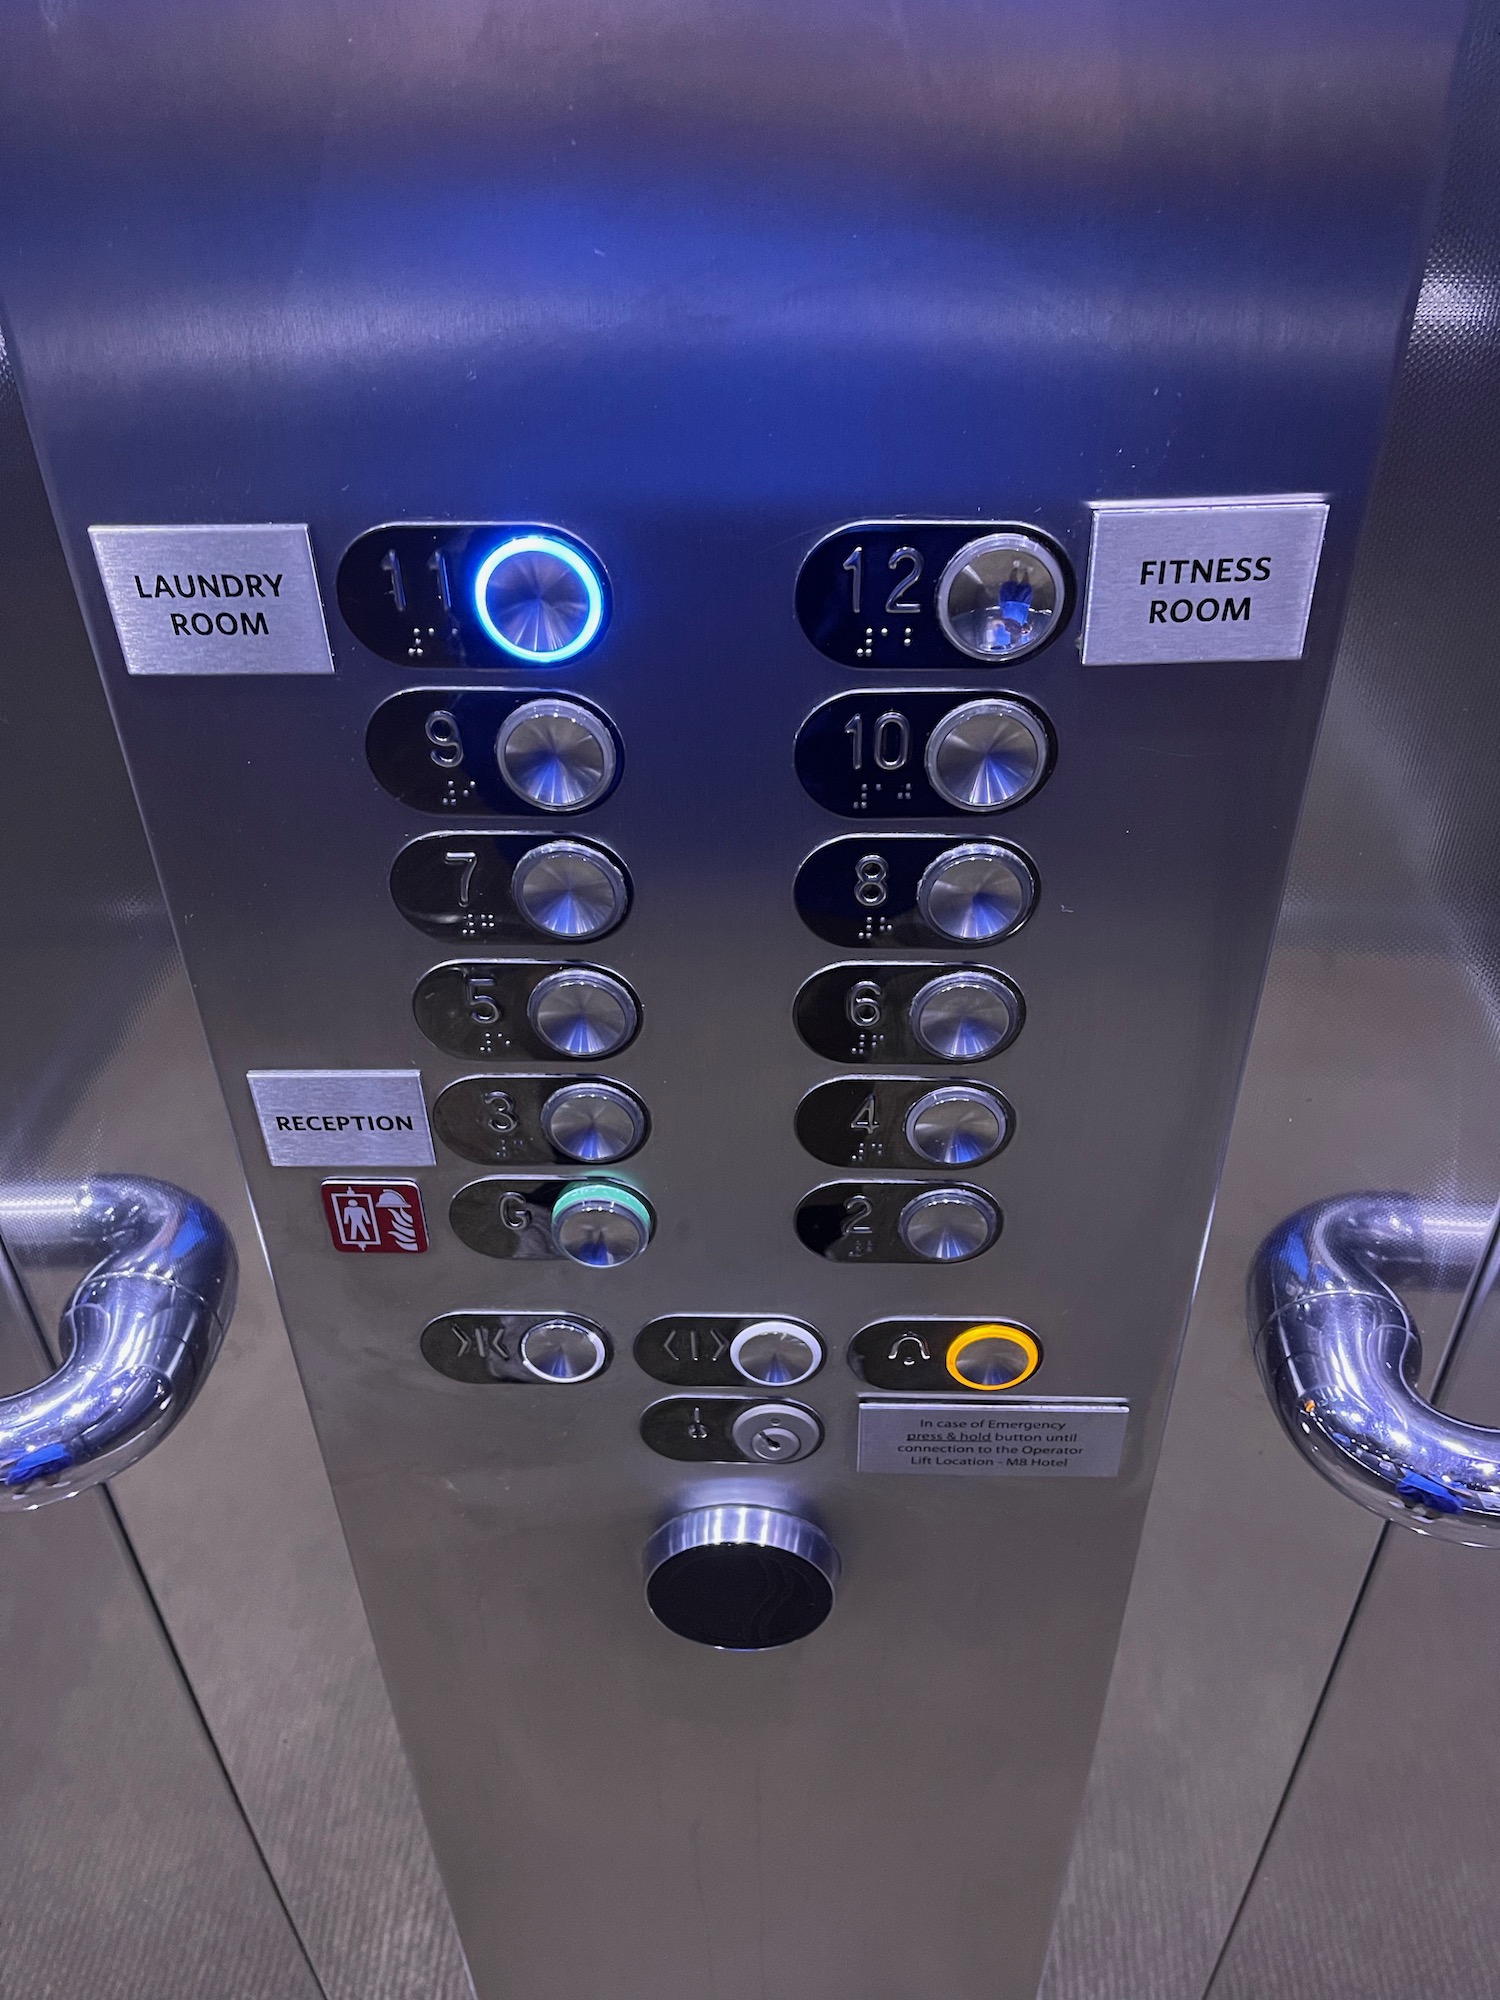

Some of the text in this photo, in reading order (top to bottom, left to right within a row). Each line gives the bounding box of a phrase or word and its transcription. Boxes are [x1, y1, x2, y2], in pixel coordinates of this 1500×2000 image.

[134, 573, 283, 598] LAUNDRY
[380, 549, 452, 611] 11
[842, 546, 922, 614] 12
[1140, 557, 1271, 585] FITNESS
[170, 612, 270, 636] ROOM
[1148, 597, 1251, 624] ROOM
[424, 709, 463, 767] 9
[844, 711, 910, 770] 10
[444, 851, 477, 907] 7
[854, 854, 888, 907] 8
[467, 977, 500, 1024] 5
[849, 980, 881, 1027] 6
[275, 1116, 414, 1132] RECEPTION
[484, 1090, 519, 1132] 3
[850, 1093, 879, 1134] 4
[499, 1191, 532, 1230] G
[843, 1195, 872, 1235] 2
[907, 1431, 1077, 1442] press & hold button until
[919, 1419, 1066, 1431] In case of Emergency
[897, 1444, 1083, 1456] connection to the Operator
[911, 1456, 932, 1466] Lift
[936, 1456, 994, 1466] Location
[1006, 1457, 1027, 1466] M8
[1031, 1457, 1068, 1467] Hotel
